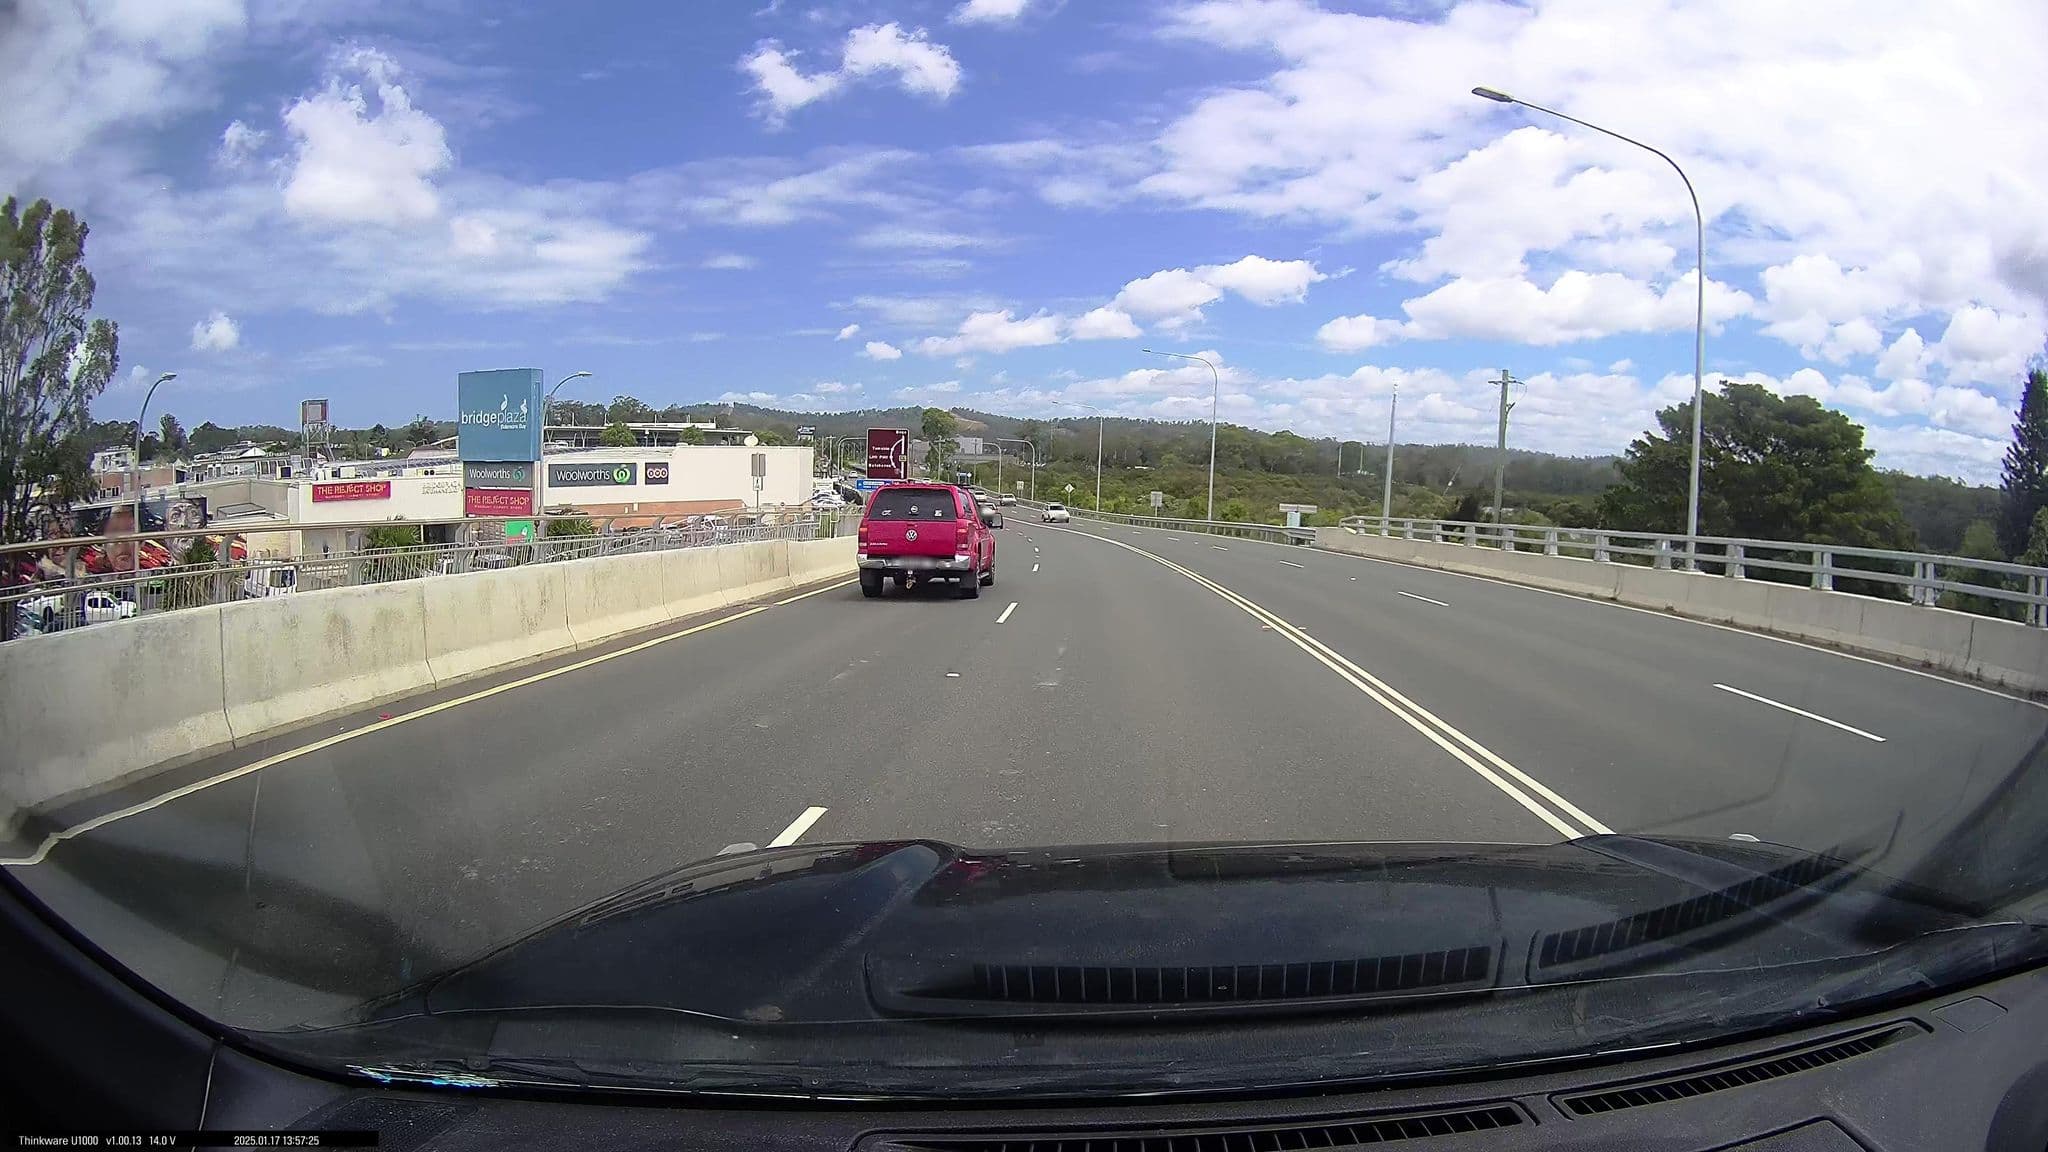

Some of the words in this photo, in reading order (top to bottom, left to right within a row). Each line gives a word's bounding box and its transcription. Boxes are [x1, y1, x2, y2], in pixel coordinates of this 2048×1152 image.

[461, 410, 527, 427] bridgeplaza
[469, 468, 511, 479] Woolworths
[556, 469, 610, 481] Woolworths
[317, 486, 333, 495] THE
[334, 484, 364, 494] REJECT
[365, 484, 386, 493] SHOP
[467, 495, 481, 504] THE
[482, 495, 509, 505] REJECT
[509, 496, 530, 506] SHOP
